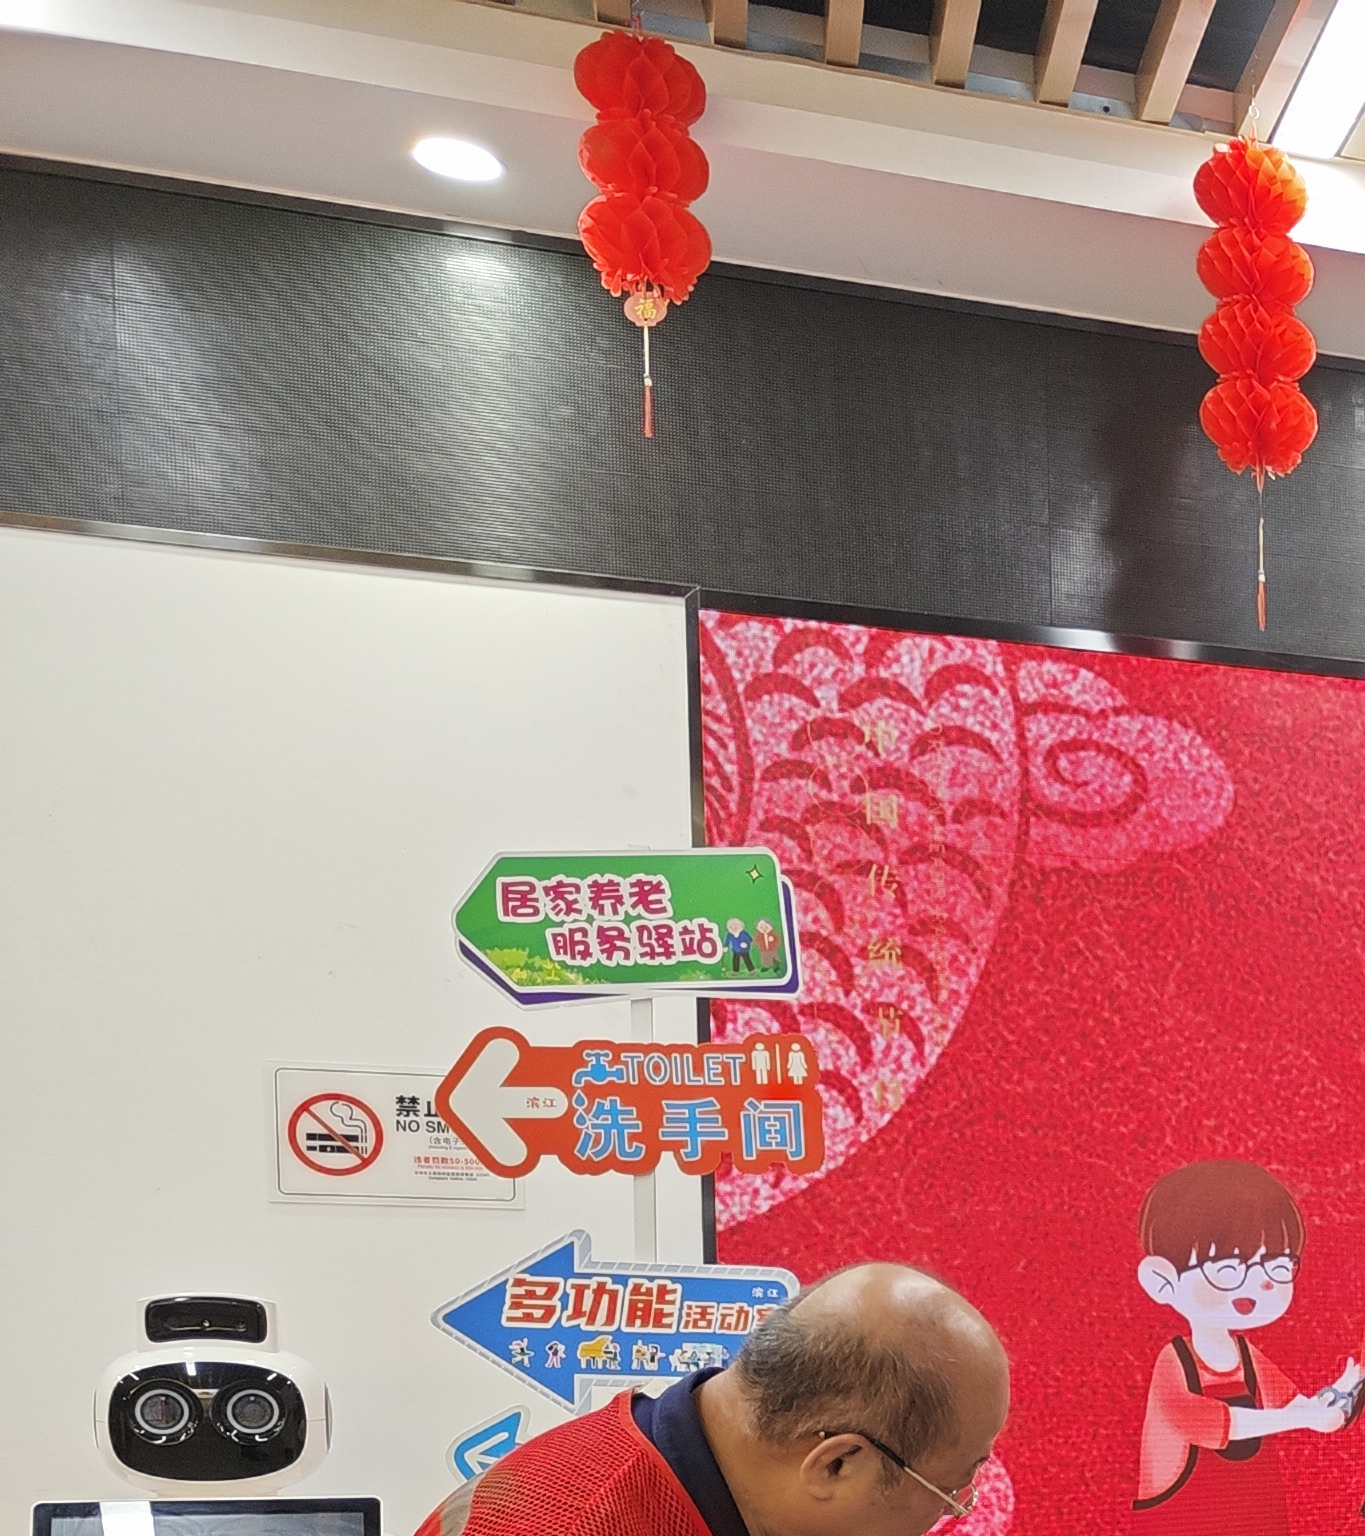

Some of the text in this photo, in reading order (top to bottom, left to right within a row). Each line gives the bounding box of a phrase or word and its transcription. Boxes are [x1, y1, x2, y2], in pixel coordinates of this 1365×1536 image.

[500, 878, 667, 919] 居家养老
[551, 922, 719, 962] 服务驿站
[620, 1053, 746, 1085] TOILET
[525, 1096, 558, 1109] 滨江
[396, 1119, 420, 1133] NO
[574, 1094, 805, 1161] 洗手间
